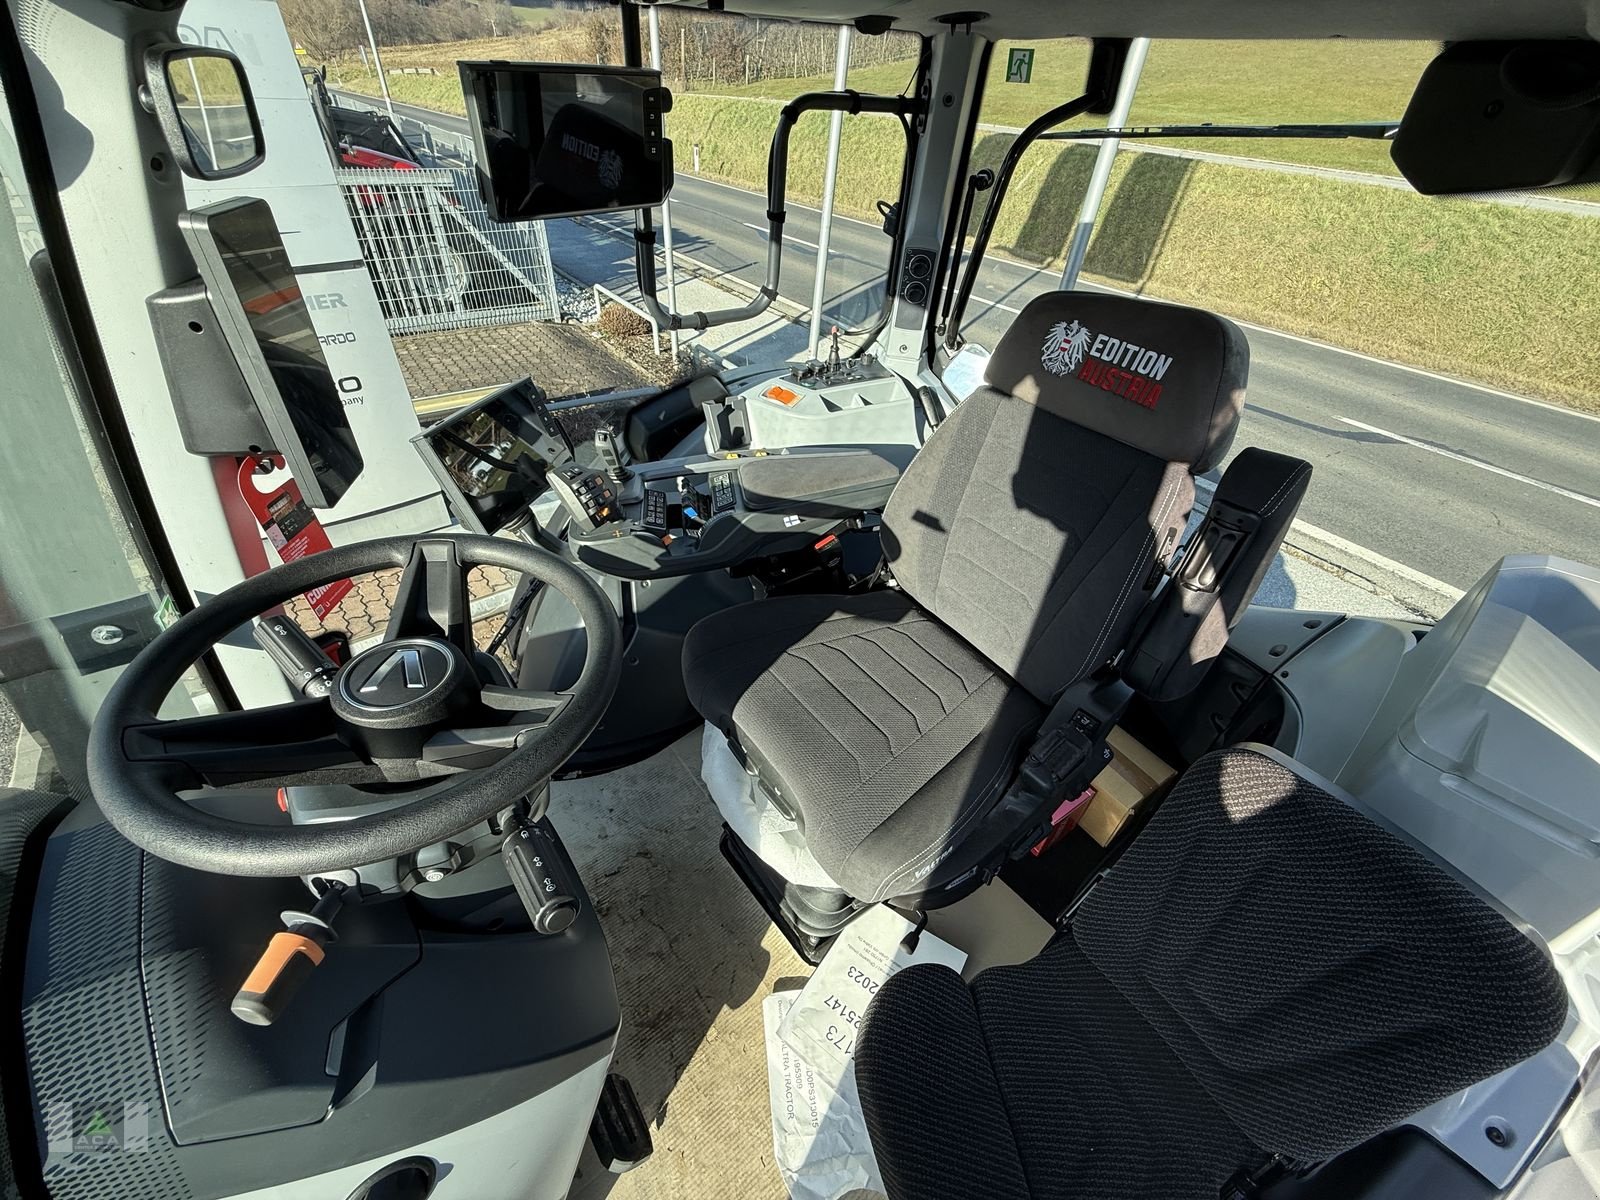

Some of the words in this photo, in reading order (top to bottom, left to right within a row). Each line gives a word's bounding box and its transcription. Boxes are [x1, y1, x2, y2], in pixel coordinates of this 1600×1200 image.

[318, 332, 356, 346] ARDO
[1089, 333, 1173, 381] EDITION
[1077, 357, 1164, 411] AUSTRIA
[847, 966, 880, 994] 2023
[826, 1025, 854, 1056] 173
[784, 1072, 795, 1120] TRACTOR
